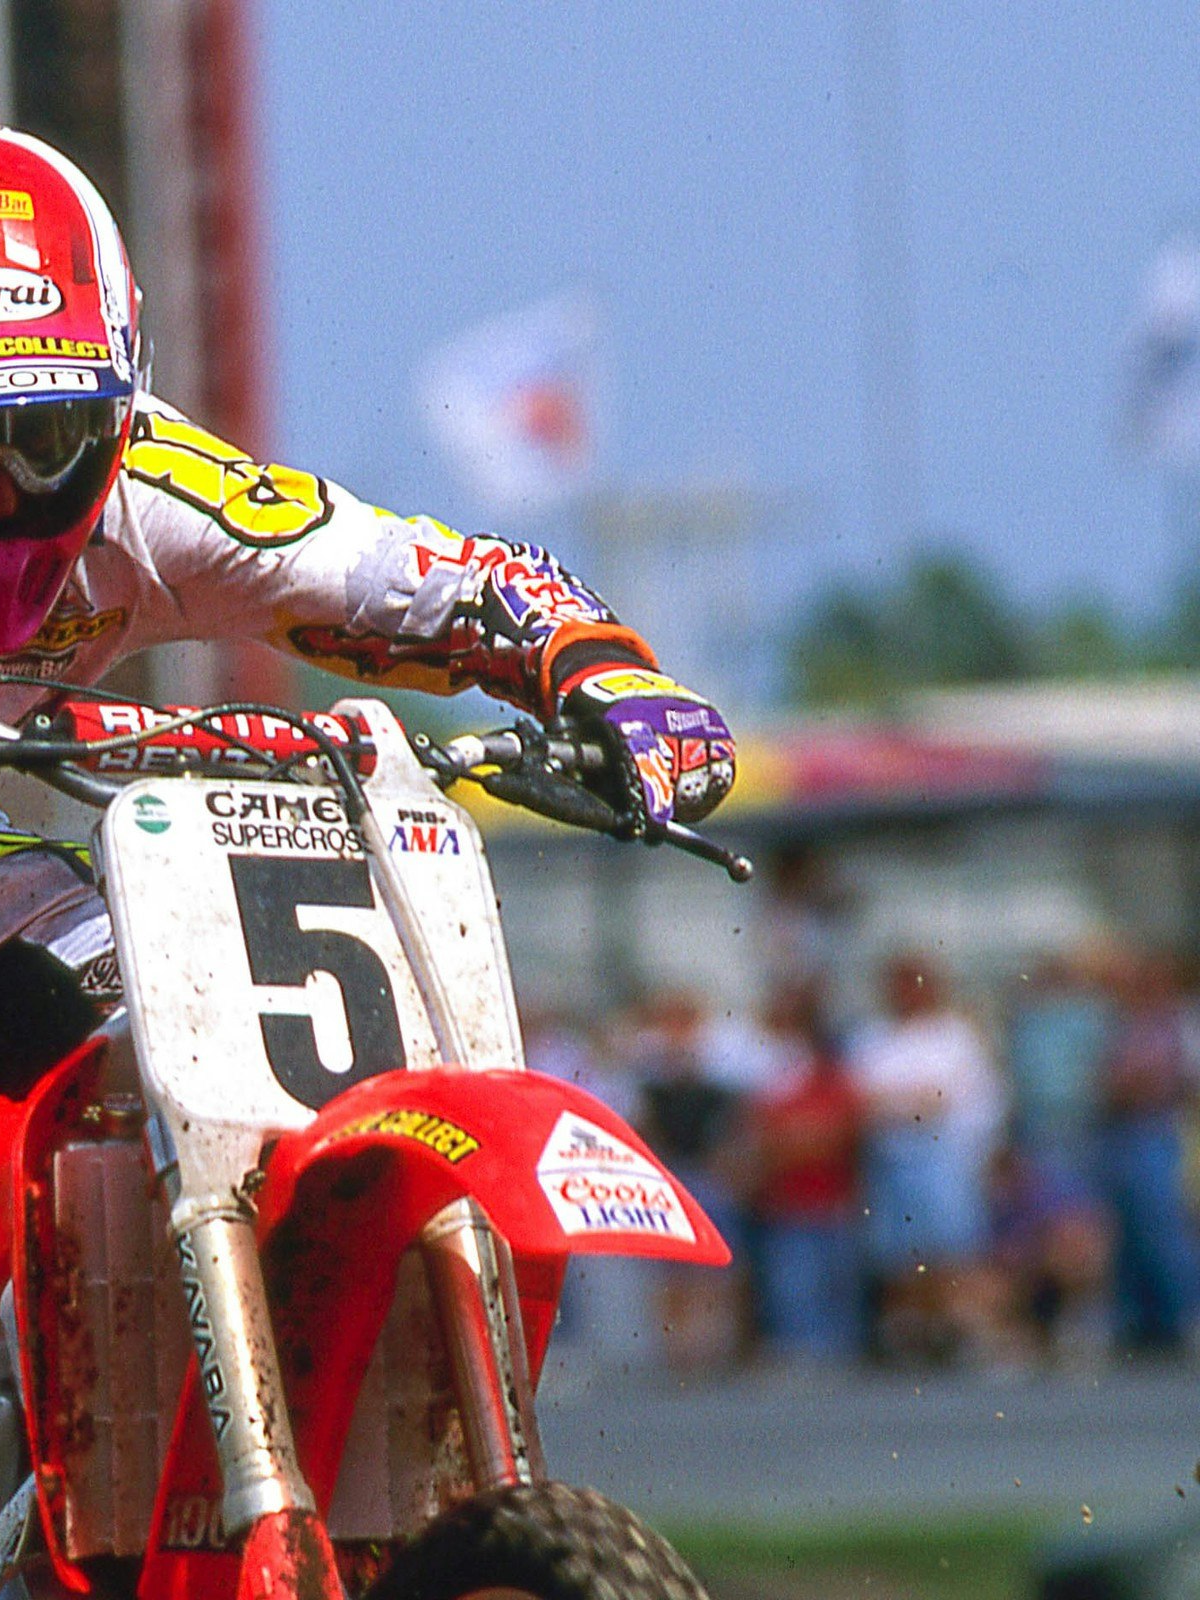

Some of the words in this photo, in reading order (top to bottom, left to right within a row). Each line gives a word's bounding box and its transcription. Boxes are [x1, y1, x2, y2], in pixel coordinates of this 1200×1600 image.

[99, 704, 370, 743] RENTHA
[205, 790, 348, 824] CAME
[389, 825, 460, 855] AMA
[228, 853, 407, 1110] 5
